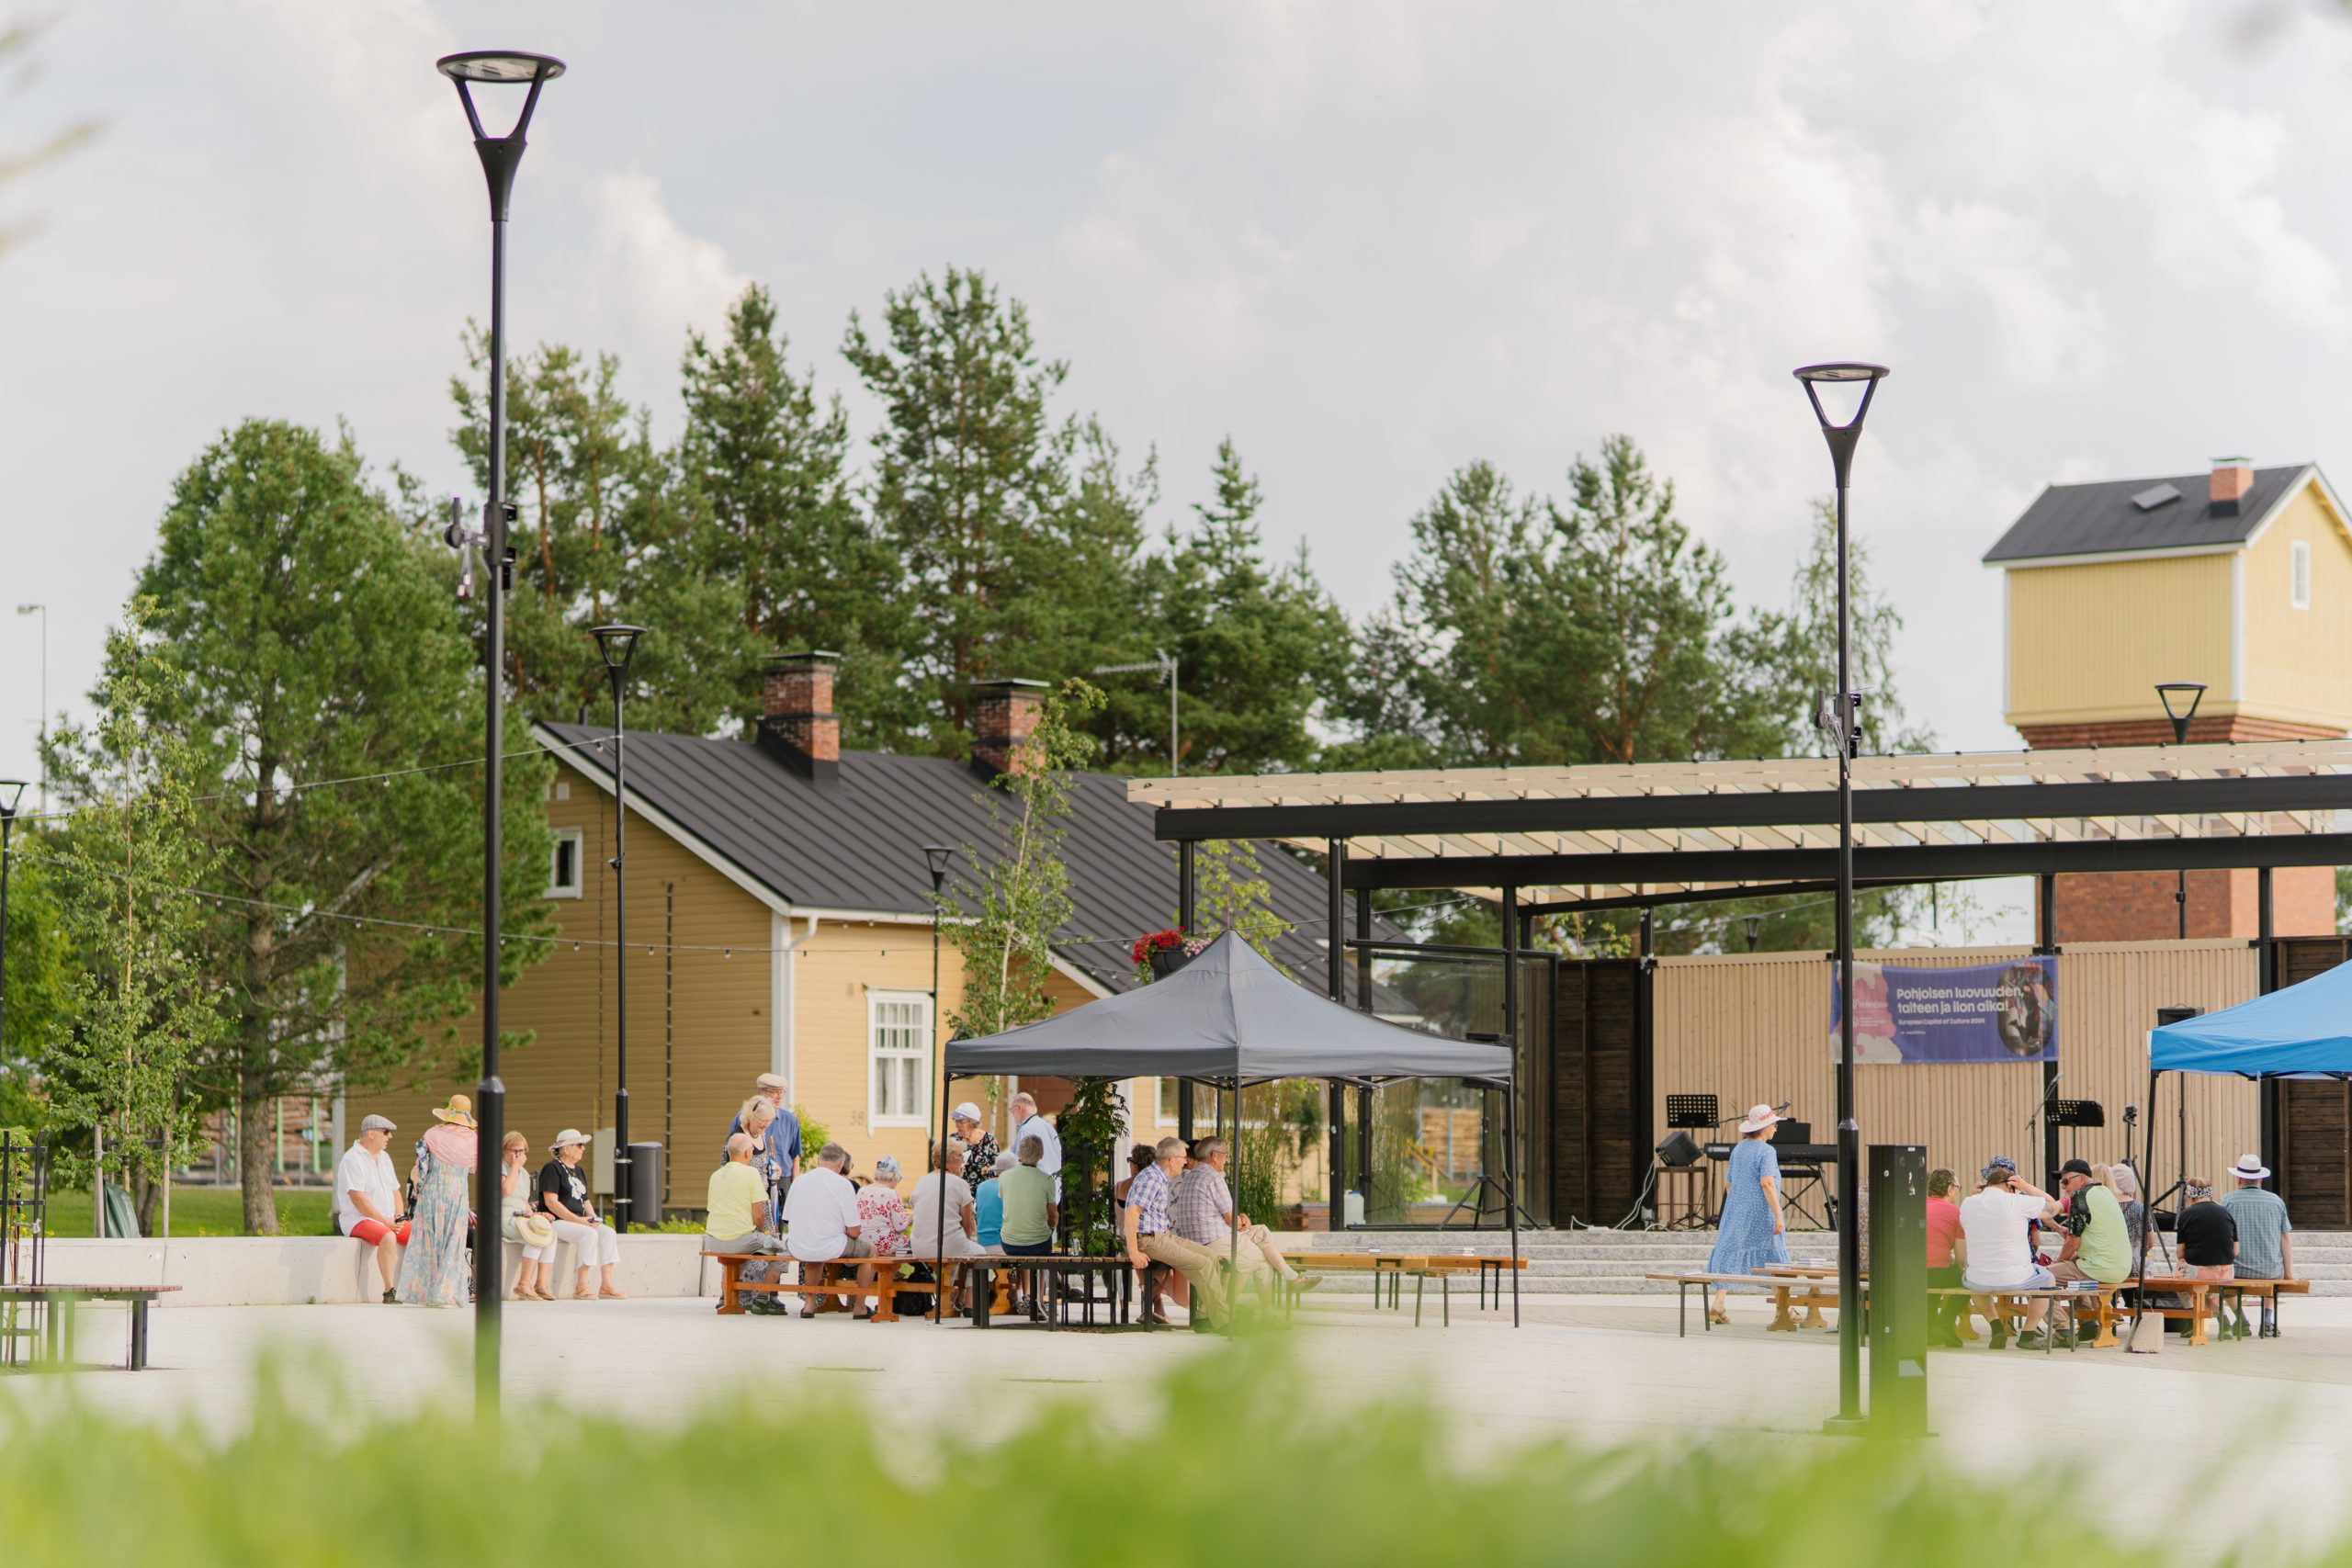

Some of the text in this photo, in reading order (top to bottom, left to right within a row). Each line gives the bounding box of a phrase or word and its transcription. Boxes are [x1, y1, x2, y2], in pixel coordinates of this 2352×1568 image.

[1896, 986, 2024, 1001] Pohjoisen luovuuden,
[1897, 1001, 1939, 1014] taiteen
[1940, 1001, 1951, 1015] ja
[1952, 1000, 1975, 1013] ilon
[1977, 999, 2009, 1012] aika!
